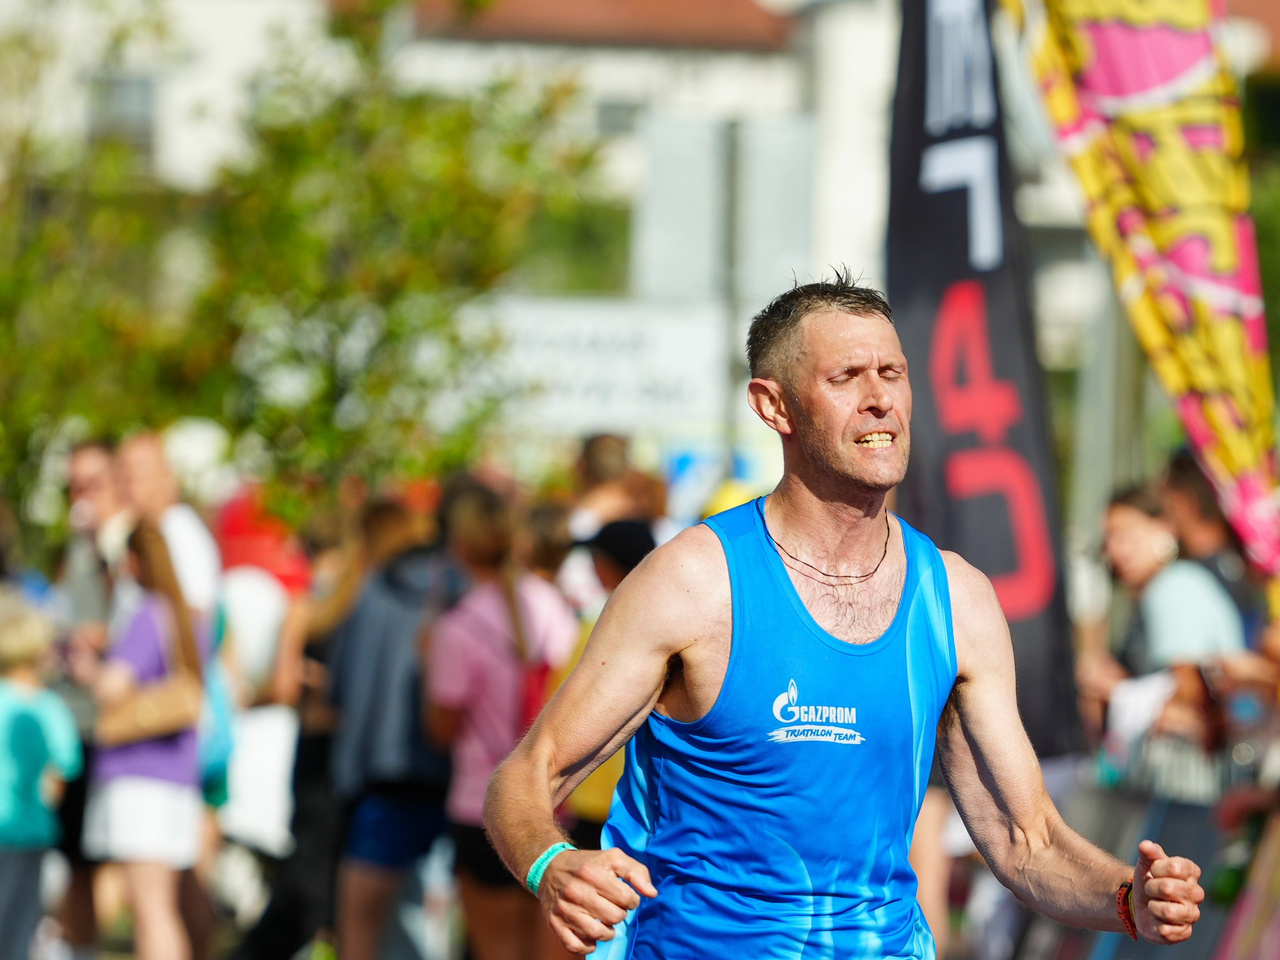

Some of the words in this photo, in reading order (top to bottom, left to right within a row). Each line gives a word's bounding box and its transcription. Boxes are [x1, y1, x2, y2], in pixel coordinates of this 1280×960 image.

[799, 706, 857, 724] GAZPROM
[785, 728, 833, 738] TRIATHLON
[833, 732, 857, 742] TEAM
